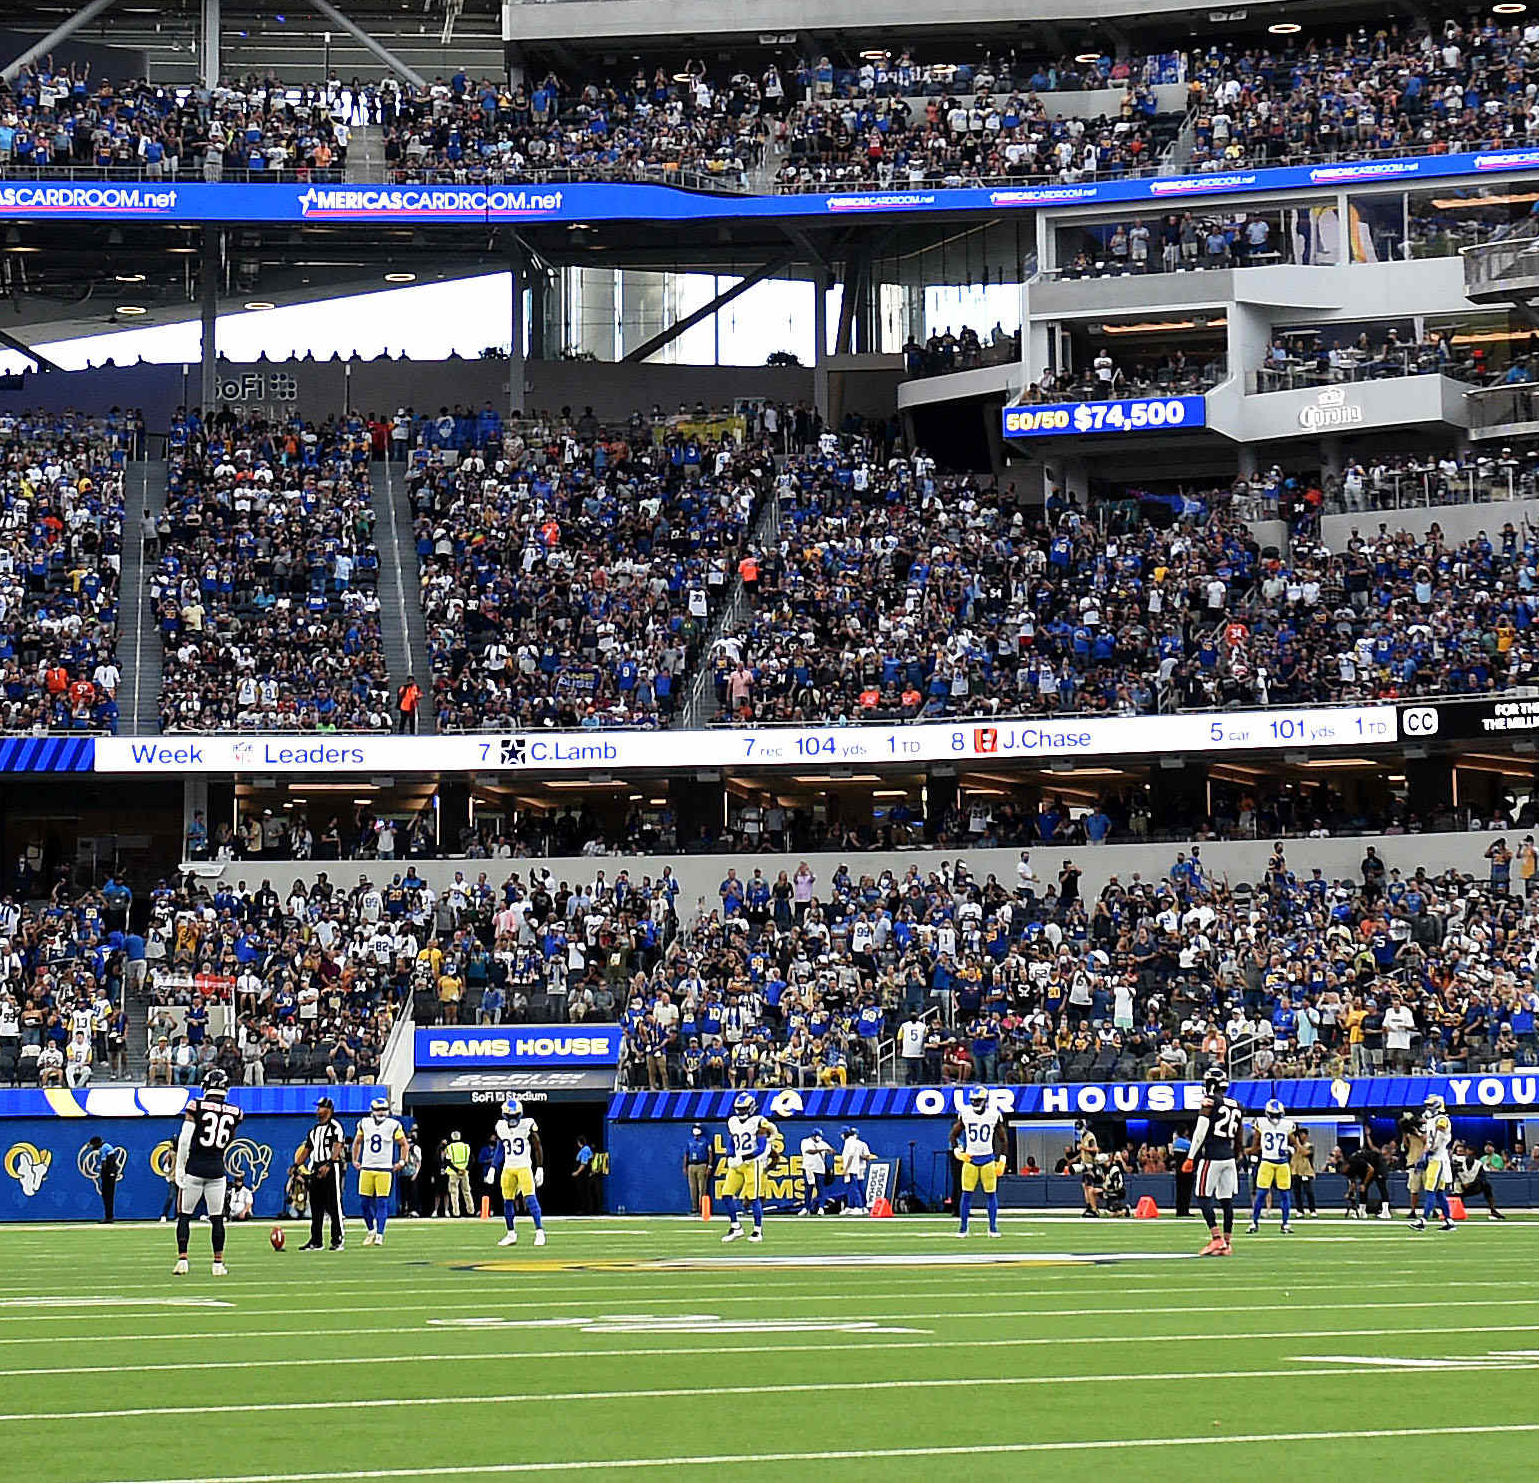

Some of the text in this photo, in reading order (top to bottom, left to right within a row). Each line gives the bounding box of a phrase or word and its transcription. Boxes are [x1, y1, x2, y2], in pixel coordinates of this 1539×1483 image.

[1006, 400, 1185, 432] 50/50 $74,500
[1299, 403, 1363, 431] Corona
[1408, 711, 1434, 732] CC
[951, 732, 964, 752] 8
[1003, 728, 1092, 750] J.Chase
[1210, 722, 1224, 743] 5
[1269, 719, 1305, 740] 101
[1355, 718, 1364, 736] 1
[1369, 722, 1388, 735] TD
[131, 743, 204, 765] Week
[264, 743, 364, 765] Leaders
[478, 743, 491, 762] 7
[530, 742, 617, 762] C.Lamb
[743, 738, 755, 757] 7
[795, 736, 837, 756] 104
[887, 736, 896, 754] 1
[900, 742, 921, 754] TD
[374, 941, 389, 952] 82
[910, 1029, 919, 1042] 5
[429, 1038, 610, 1057] RAMS HOUSE
[471, 1090, 548, 1103] SoFi Stadium
[199, 1110, 232, 1147] 36
[969, 1122, 992, 1143] 50
[1219, 1106, 1240, 1139] 26
[370, 1133, 383, 1153] 8
[1263, 1132, 1285, 1152] 37
